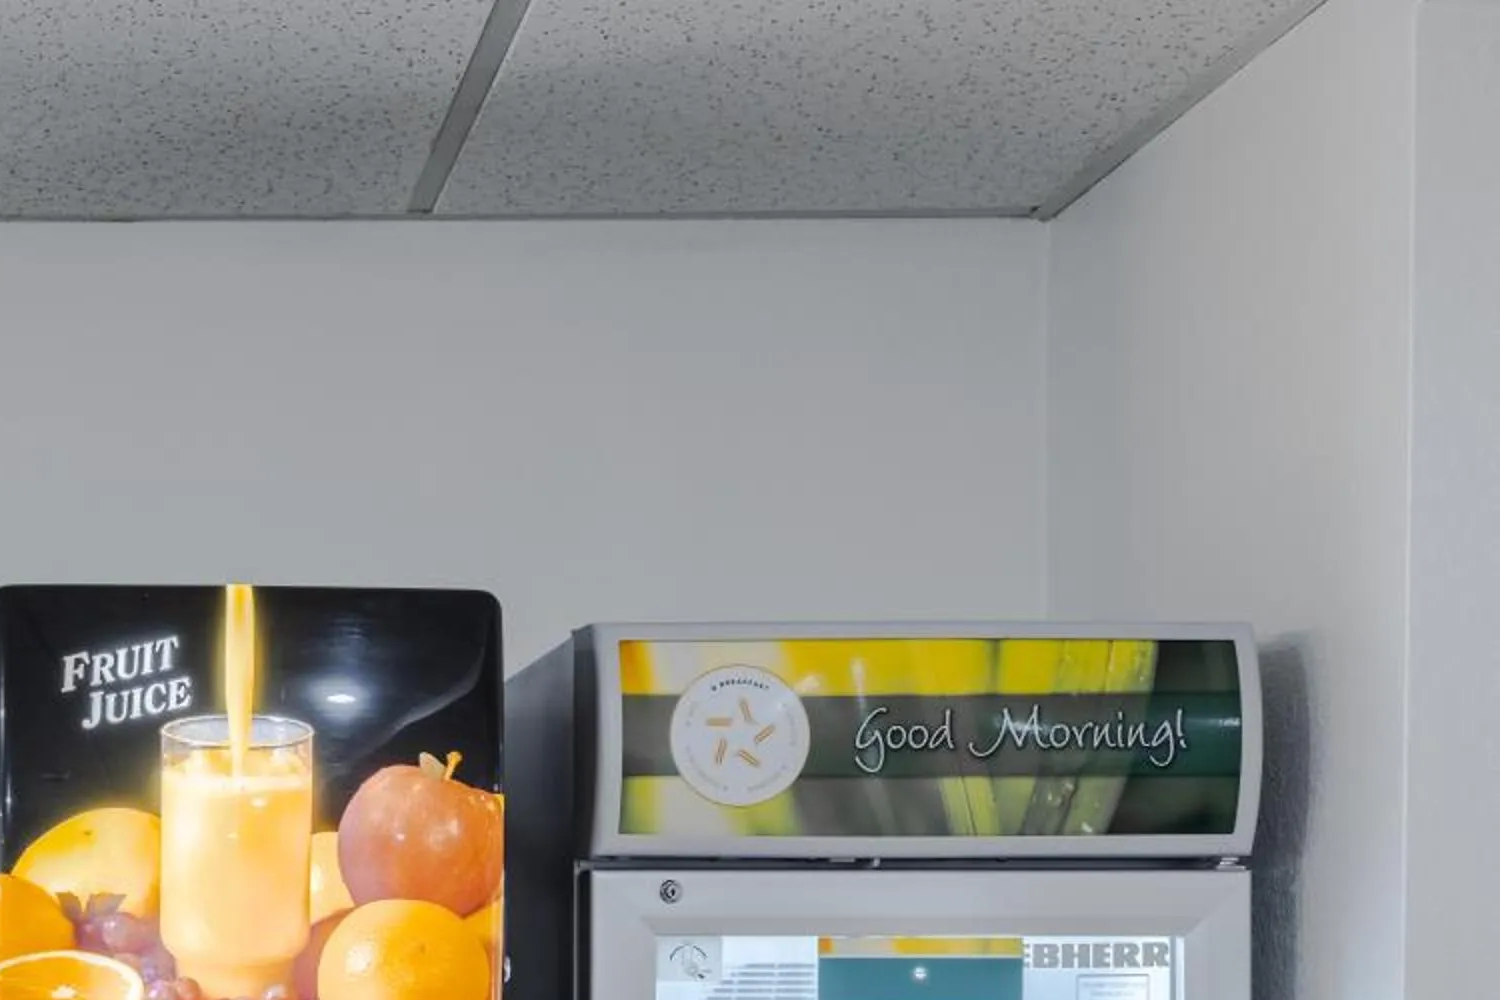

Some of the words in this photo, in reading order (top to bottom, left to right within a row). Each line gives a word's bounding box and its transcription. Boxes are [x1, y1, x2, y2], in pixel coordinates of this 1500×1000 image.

[61, 635, 180, 693] FRUIT
[82, 676, 193, 729] JUICE
[854, 707, 956, 773] Good
[968, 703, 1188, 767] Morning!
